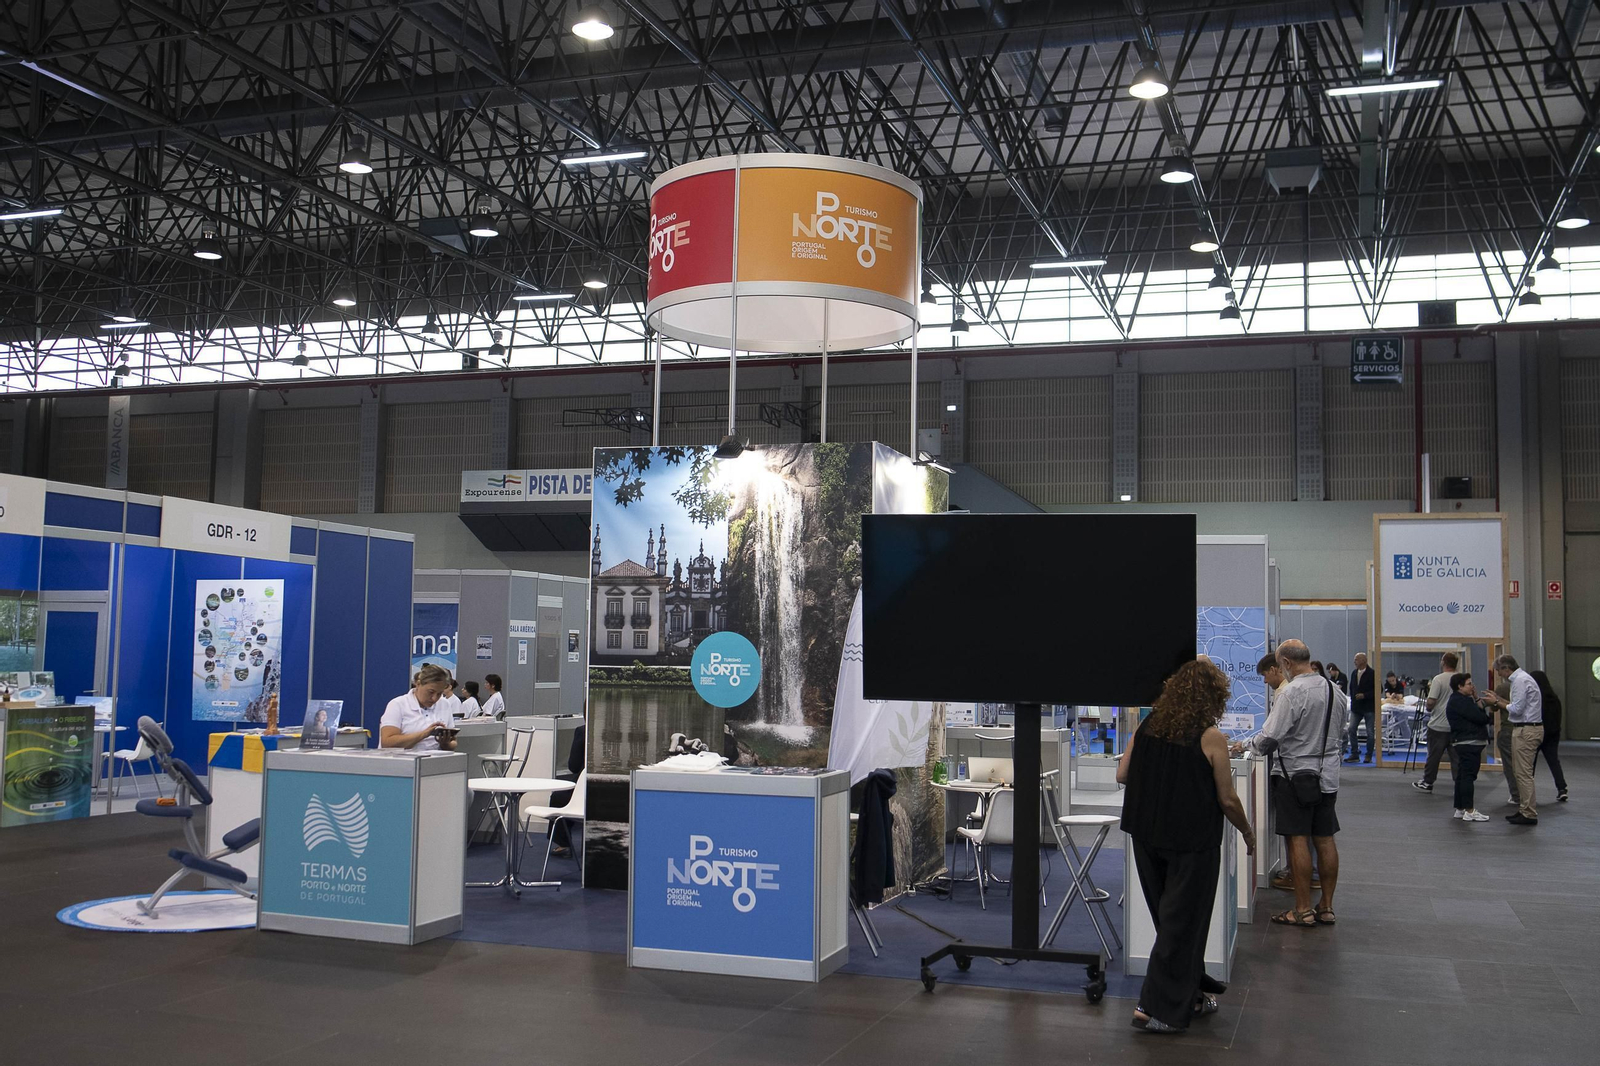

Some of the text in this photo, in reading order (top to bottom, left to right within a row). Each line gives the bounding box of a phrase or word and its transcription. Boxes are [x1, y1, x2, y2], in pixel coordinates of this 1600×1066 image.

[844, 205, 878, 218] TURISMO
[792, 213, 892, 252] NORTE
[529, 474, 591, 495] PISTA DE
[464, 489, 522, 497] Expourense
[207, 523, 233, 539] GDR
[245, 528, 257, 542] 12
[1417, 556, 1460, 566] XUNTA
[1417, 568, 1487, 578] DE GALICIA
[1398, 604, 1444, 612] Xacobeo
[520, 624, 536, 633] AMÉRICA
[701, 663, 751, 676] NORTE
[1216, 661, 1256, 672] alia Per
[719, 848, 758, 858] TURISMO
[301, 862, 367, 881] TERMAS
[668, 858, 780, 890] NORTE
[301, 880, 330, 890] PORTO
[338, 884, 366, 893] NORTE
[300, 892, 366, 905] DE PORTUGAL
